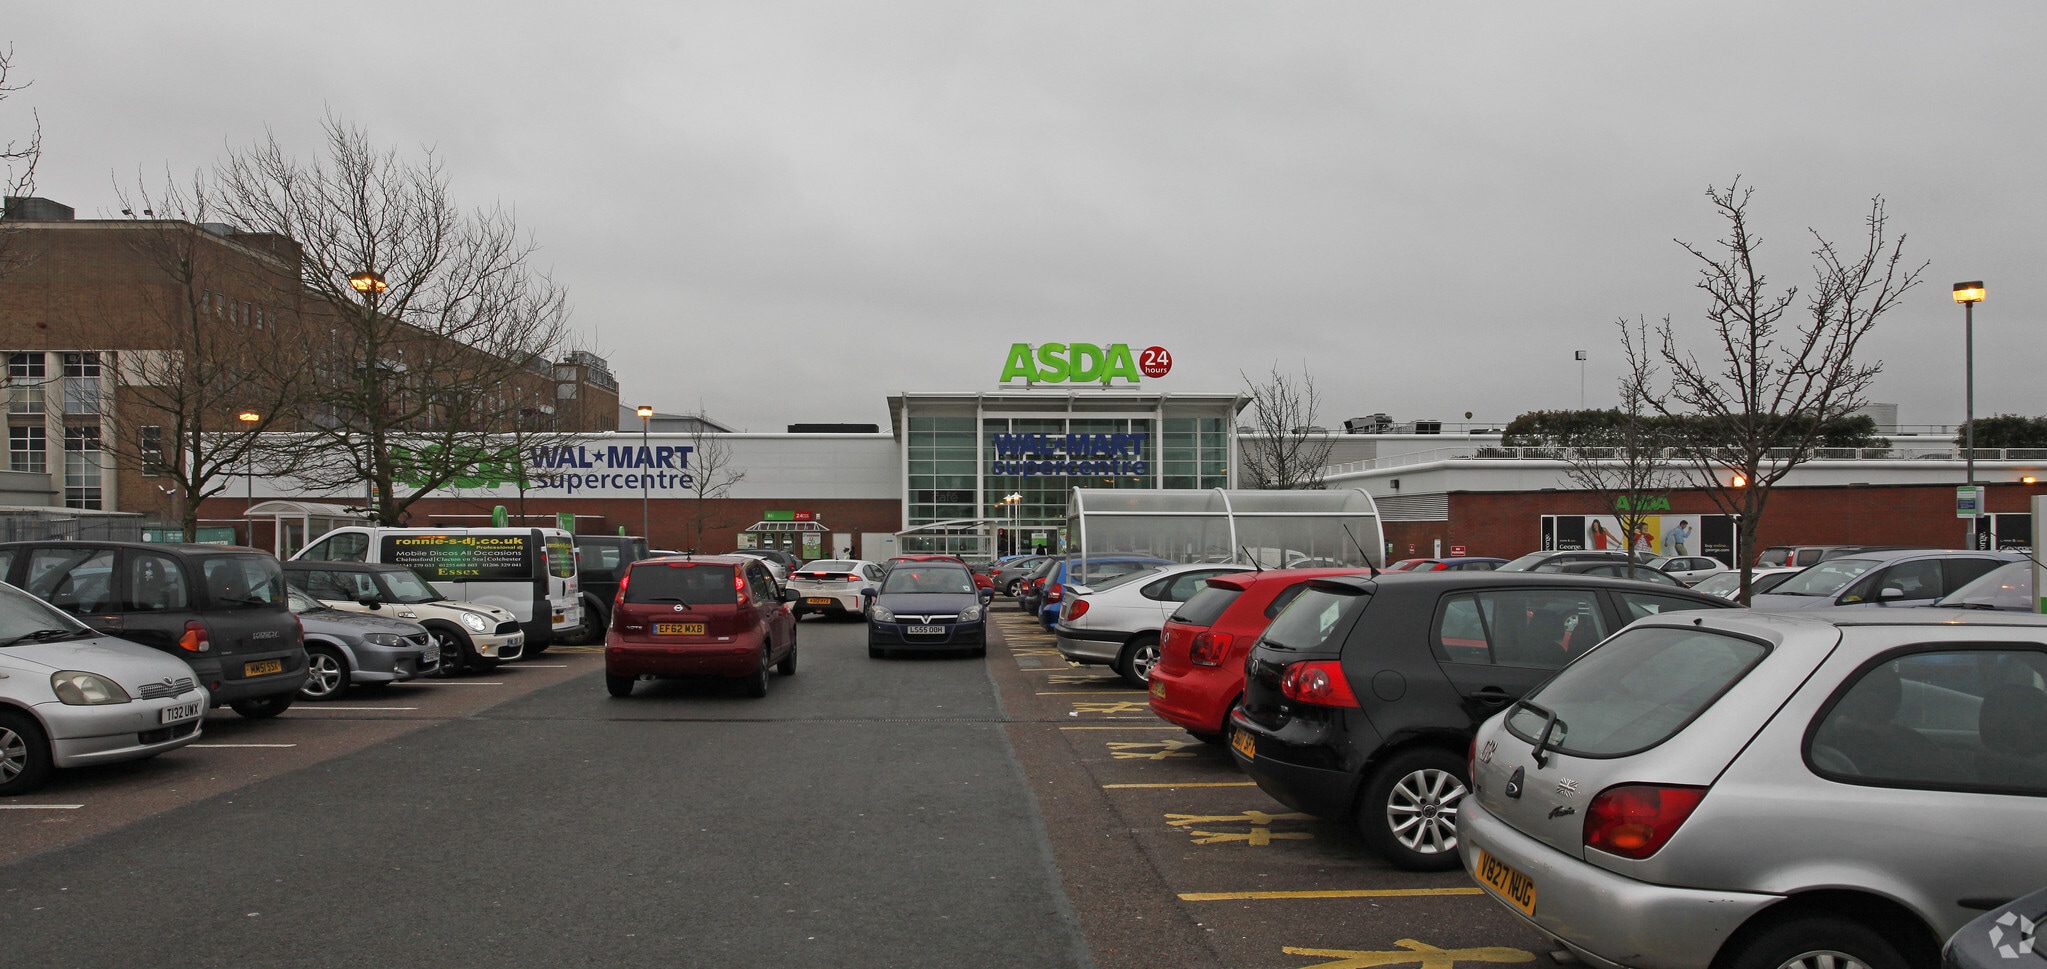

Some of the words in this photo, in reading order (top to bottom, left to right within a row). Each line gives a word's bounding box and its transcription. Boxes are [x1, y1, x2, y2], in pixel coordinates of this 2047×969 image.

[1000, 343, 1140, 383] ASDA
[1145, 350, 1169, 366] 24
[1145, 366, 1168, 374] hours
[992, 456, 1147, 481] supercentre
[538, 470, 694, 494] supercentre
[396, 538, 523, 546] ronnie-s-dj.co.uk
[659, 624, 683, 633] EF62
[167, 706, 184, 721] T132
[1481, 851, 1510, 890] V827
[1508, 873, 1534, 908] NUG
